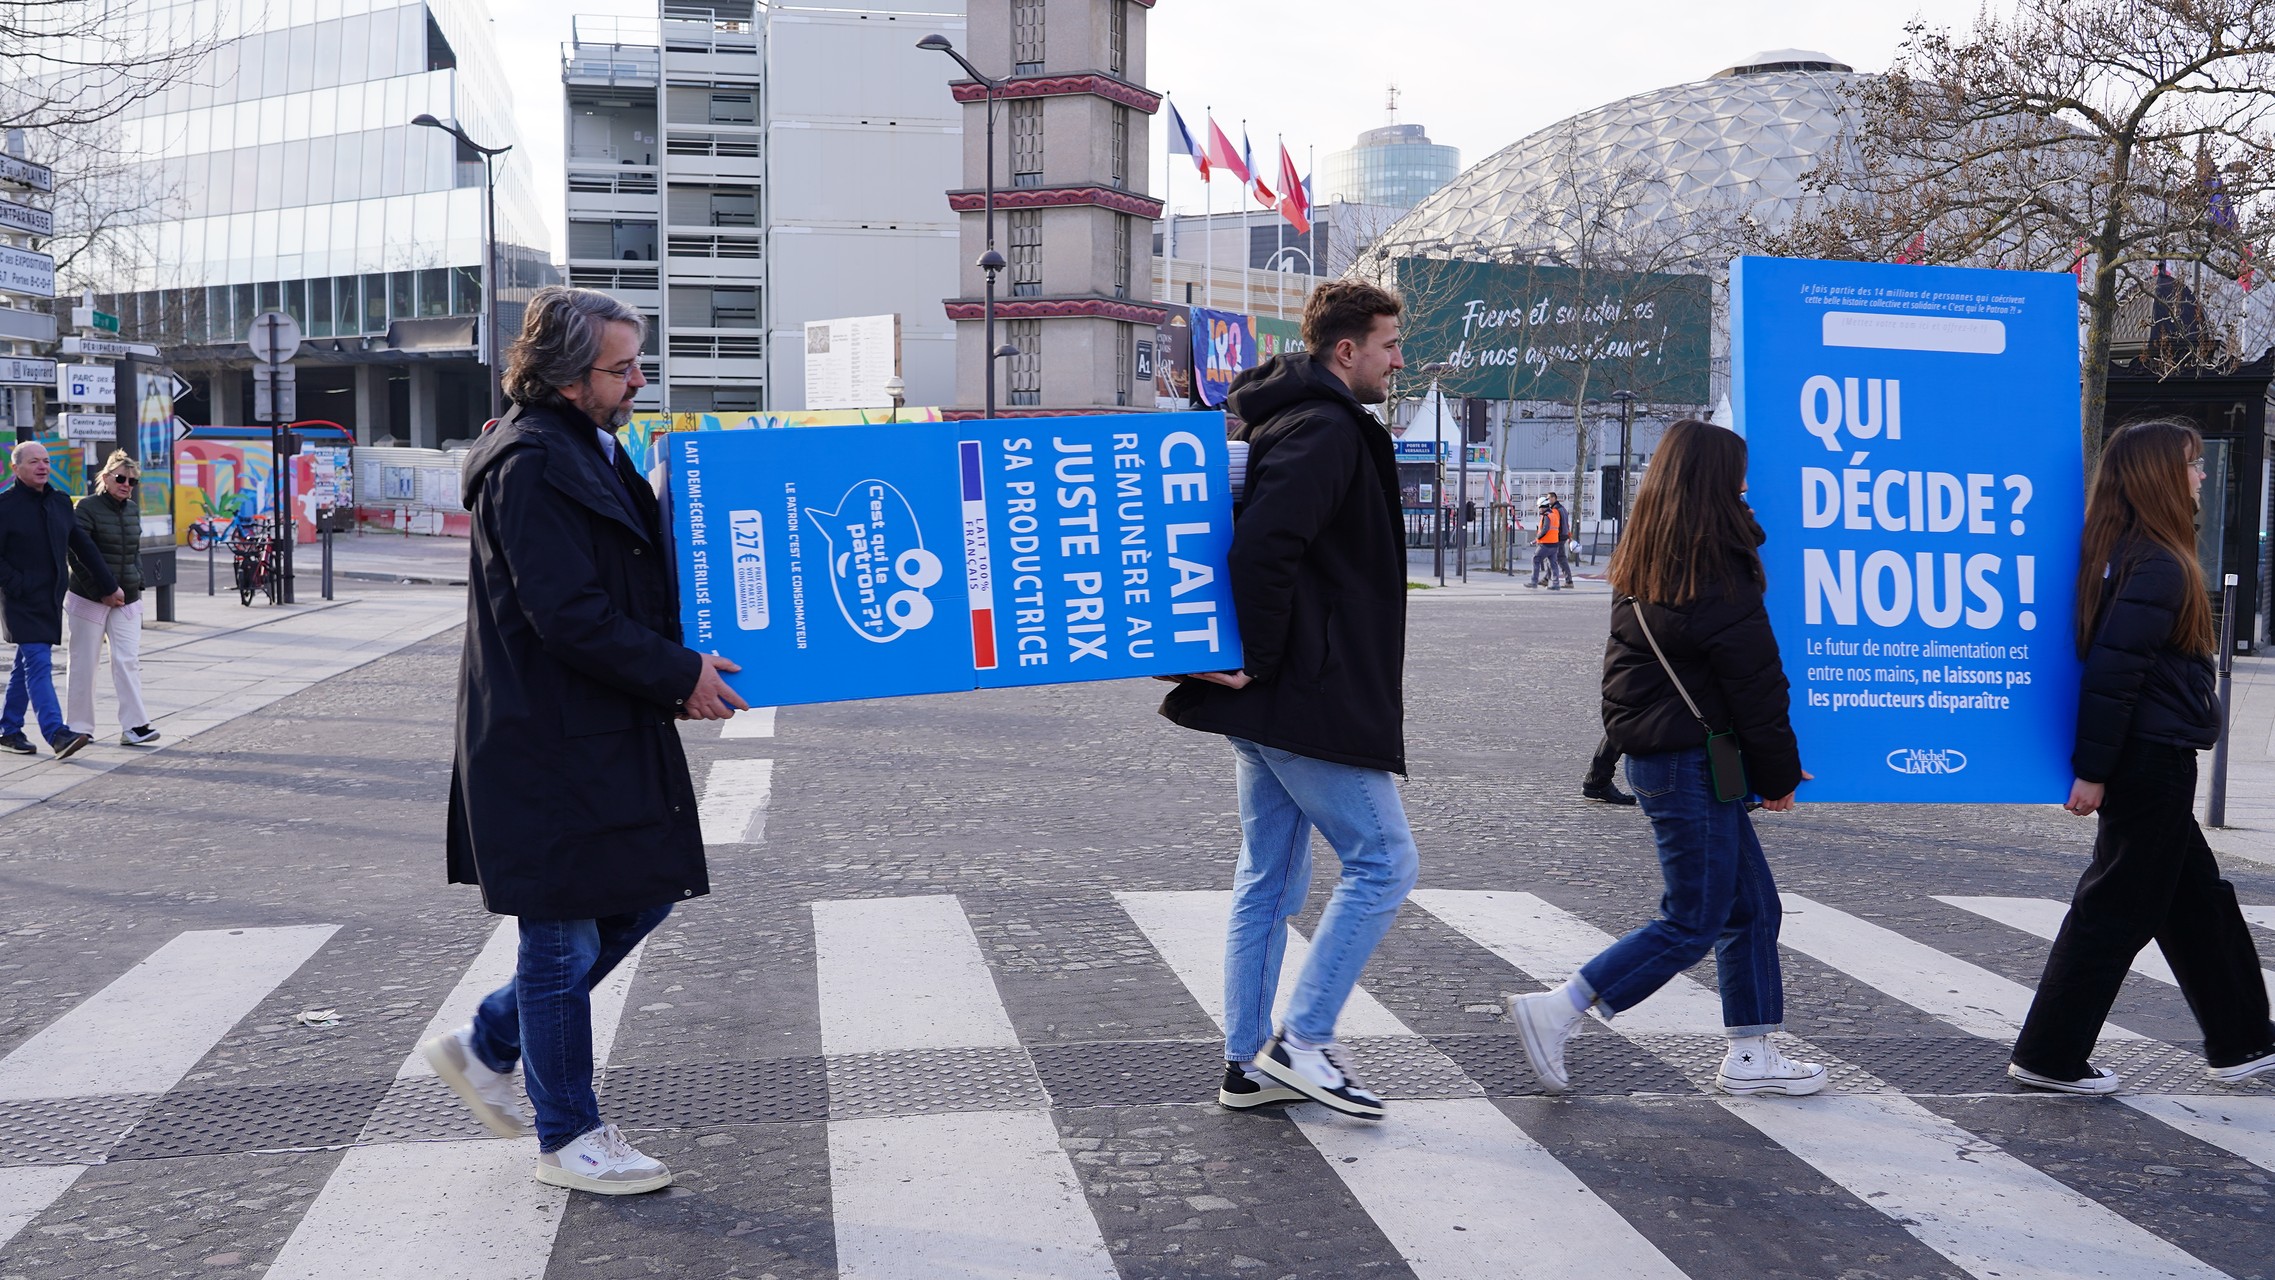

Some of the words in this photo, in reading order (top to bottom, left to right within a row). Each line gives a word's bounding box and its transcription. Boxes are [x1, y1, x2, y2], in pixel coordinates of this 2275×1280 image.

[22, 167, 48, 184] PLAINE
[0, 205, 49, 229] ONTPARNASSE
[15, 255, 51, 272] EXPOSITIONS
[1800, 283, 1810, 294] Je
[1811, 283, 1828, 295] fais
[1830, 286, 1856, 296] partie
[1857, 286, 1872, 296] des
[1874, 288, 1884, 296] 14
[1886, 289, 1918, 299] millions
[1920, 290, 1931, 299] de
[1932, 292, 1973, 302] personnes
[1975, 294, 1989, 304] qui
[1805, 296, 1822, 304] cette
[1823, 296, 1840, 305] belle
[1842, 297, 1868, 307] histoire
[1869, 298, 1901, 309] collective
[1902, 301, 1910, 309] et
[1910, 301, 1941, 310] solidaire
[1948, 303, 1965, 312] C'est
[1965, 304, 1977, 314] qui
[1978, 304, 1985, 312] le
[1985, 305, 2008, 314] Patron
[1462, 299, 1523, 338] Fiers
[1529, 297, 1551, 325] et
[1555, 294, 1655, 325] soidaies
[82, 341, 132, 353] PÉRIPHÉRIQUE
[1449, 340, 1475, 369] de
[1480, 346, 1519, 367] nos
[22, 364, 54, 380] Vaugirard
[1138, 353, 1151, 373] A1
[72, 373, 94, 383] PARC
[72, 418, 95, 427] Centre
[98, 419, 116, 428] Spor
[1800, 374, 1901, 452] QUI
[73, 428, 116, 438] Aquabouleva
[684, 441, 700, 465] LAIT
[1002, 437, 1034, 471] SA
[1159, 431, 1209, 505] CE
[785, 482, 796, 494] LE
[1053, 436, 1100, 557] JUSTE
[686, 469, 708, 546] DEMI-ÉCRÉMÉ
[786, 496, 799, 531] PATRON
[869, 485, 886, 529] C'est
[1112, 433, 1153, 605] RÉMUNÈRE
[732, 517, 760, 549] 1,27
[789, 534, 801, 558] C'EST
[976, 518, 986, 548] LAIT
[870, 534, 889, 562] qui
[965, 521, 979, 590] FRANÇAIS
[693, 550, 713, 605] STÉRILISÉ
[791, 561, 802, 573] LE
[875, 566, 890, 584] le
[979, 555, 990, 592] 100%
[1005, 480, 1048, 667] PRODUCTRICE
[738, 567, 749, 622] CONSOMMATEURS
[1165, 521, 1220, 653] LAIT
[697, 609, 713, 643] U.H.T.
[791, 575, 808, 650] CONSOMMATEUR
[1063, 571, 1108, 663] PRIX
[1125, 616, 1154, 659] AU
[1807, 638, 1823, 655] Le
[1825, 637, 1860, 656] futur
[1862, 638, 1880, 657] de
[1883, 641, 1920, 657] notre
[1922, 639, 2006, 659] alimentation
[2009, 644, 2029, 660] est
[1807, 665, 1844, 681] entre
[1847, 667, 1872, 682] nos
[1875, 665, 1919, 685] mains,
[1922, 669, 1942, 683] ne
[1944, 665, 2003, 684] laissons
[2005, 670, 2032, 690] pas
[1808, 688, 1830, 706] les
[1833, 689, 1925, 712] producteurs
[1928, 690, 2010, 714] disparaître
[1904, 757, 1951, 775] LAFON
[1909, 748, 1947, 761] Michel
